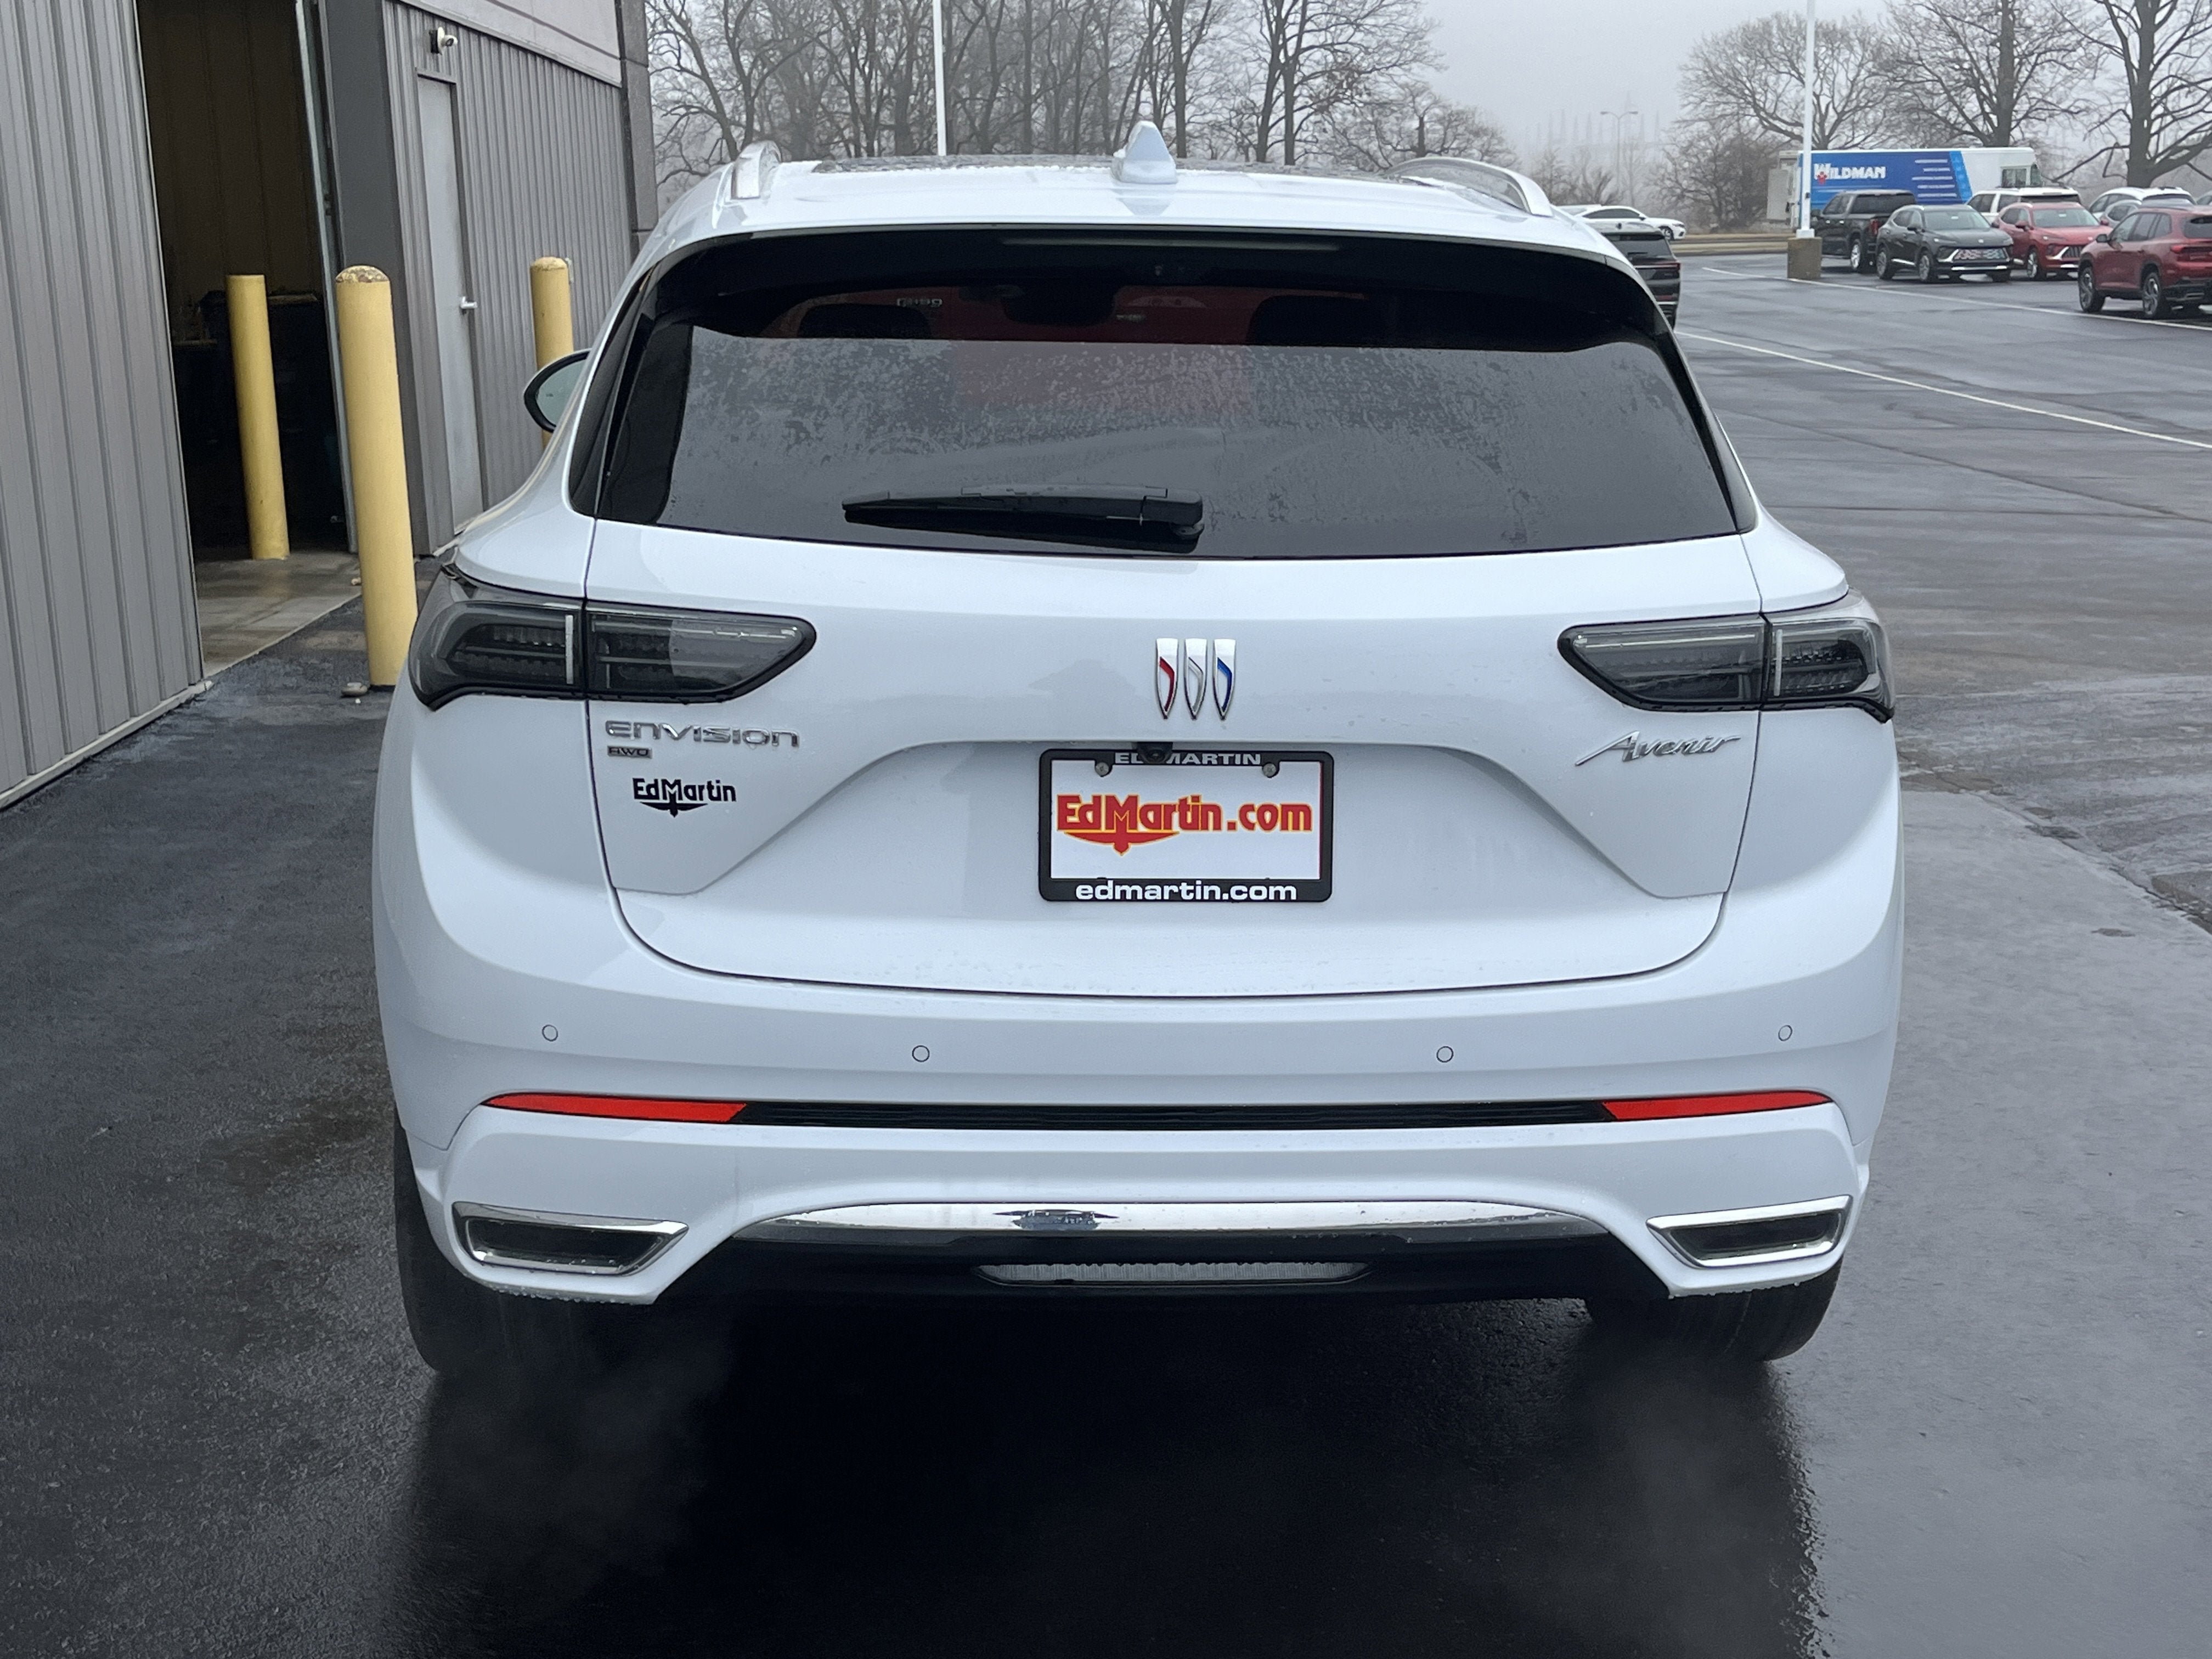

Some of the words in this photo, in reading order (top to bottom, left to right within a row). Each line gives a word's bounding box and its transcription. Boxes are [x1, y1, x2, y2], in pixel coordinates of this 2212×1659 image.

[1814, 163, 1886, 180] WILDMAN
[605, 720, 800, 748] ENVISION
[608, 746, 650, 758] AWD
[1575, 730, 1741, 766] Avenir
[1057, 794, 1312, 837] EdMartin.com
[1075, 880, 1297, 901] edmartin.com
